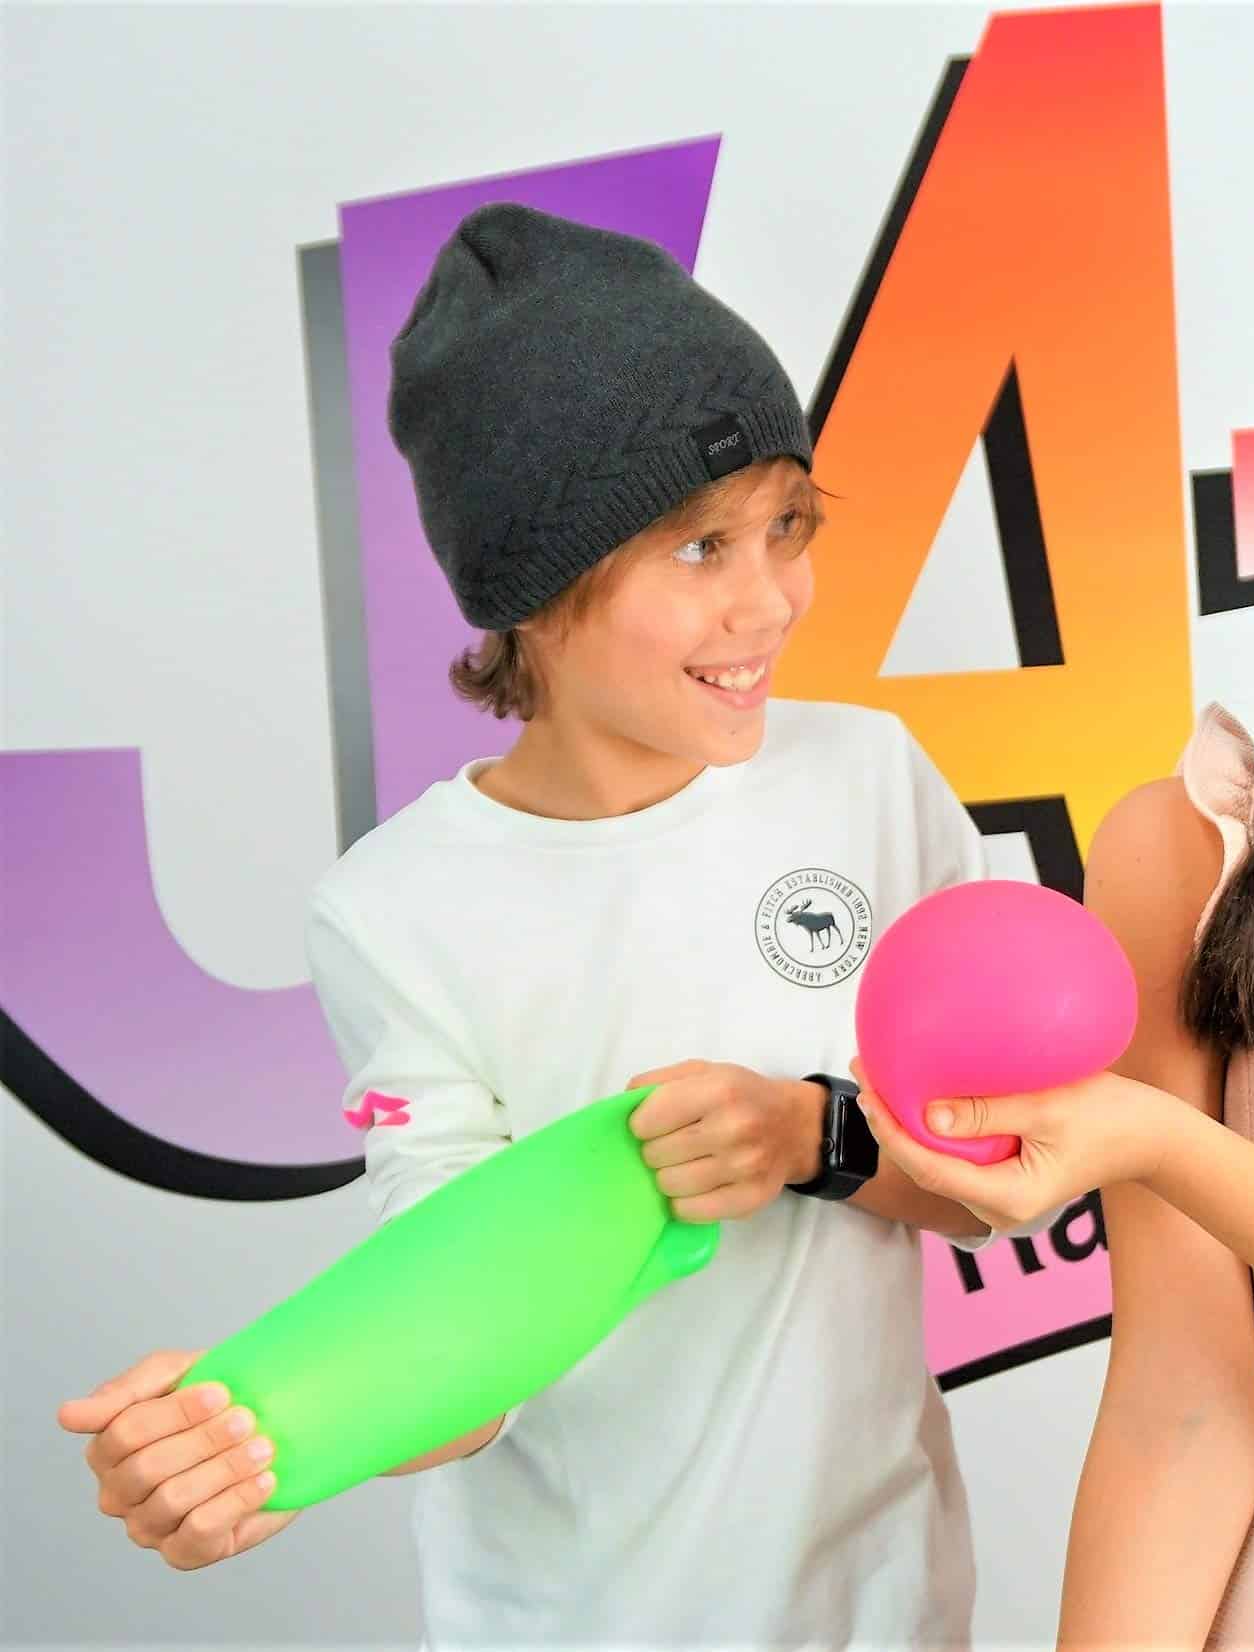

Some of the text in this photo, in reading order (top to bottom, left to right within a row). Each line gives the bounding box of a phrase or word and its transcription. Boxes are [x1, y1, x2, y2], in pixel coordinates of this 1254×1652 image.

[707, 432, 740, 456] SPORT
[784, 873, 853, 899] ESTABLISHED
[761, 888, 784, 919] FITCH
[851, 896, 868, 921] 1892
[855, 926, 869, 951] NEW
[761, 935, 822, 983] ABERCROMBIE
[832, 953, 858, 979] YORK
